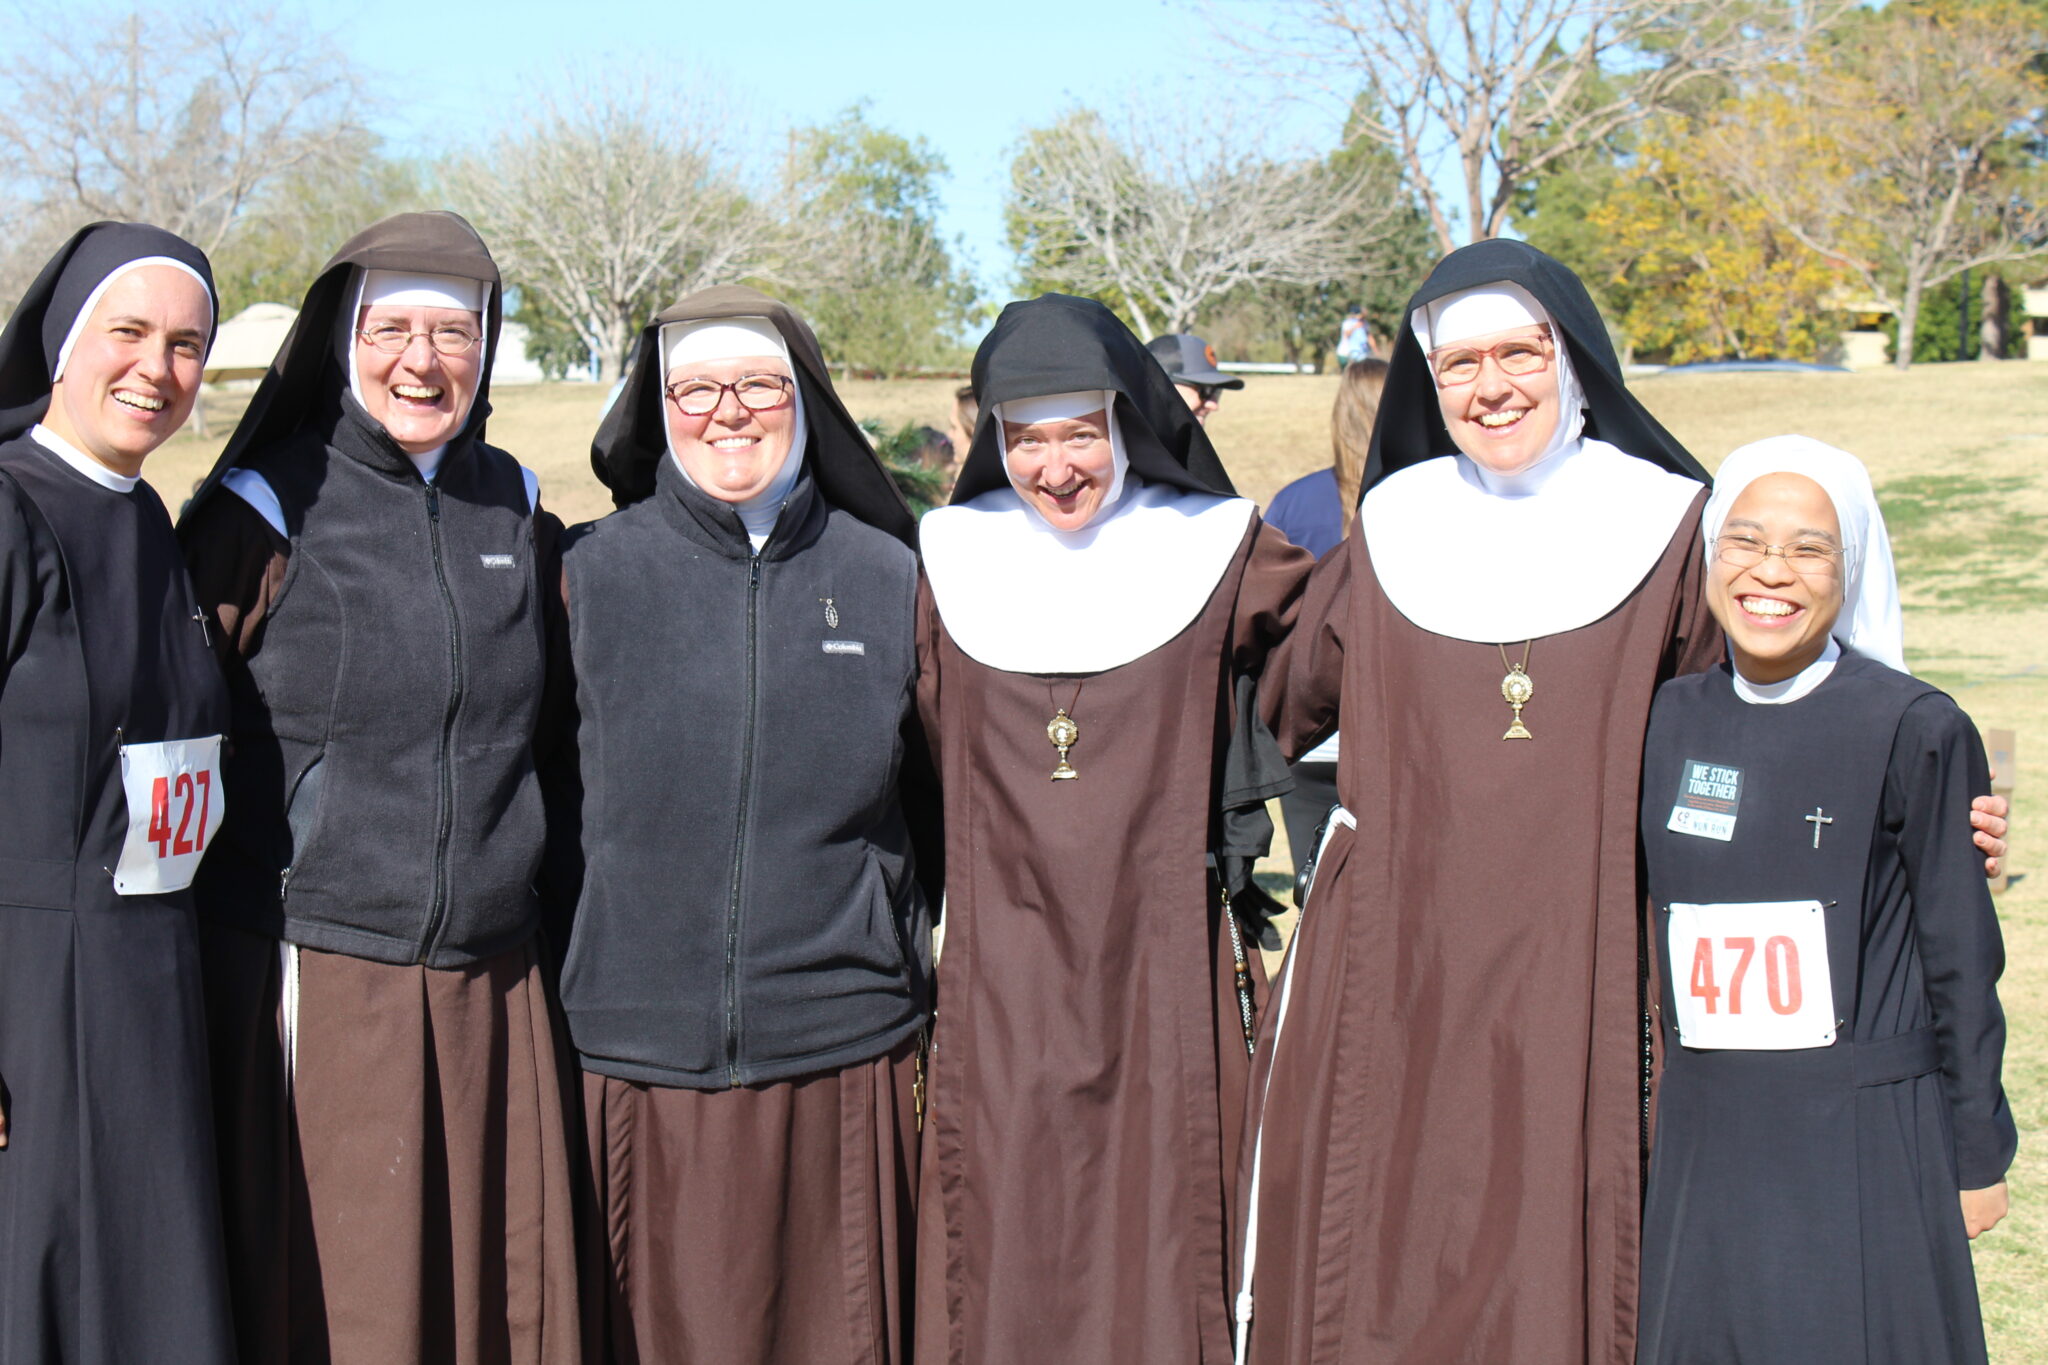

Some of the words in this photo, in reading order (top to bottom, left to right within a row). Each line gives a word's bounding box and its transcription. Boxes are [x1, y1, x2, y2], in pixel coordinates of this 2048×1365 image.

[1688, 778, 1737, 800] TOGETHER
[1692, 764, 1710, 780] WE
[1709, 767, 1740, 785] STICK
[148, 769, 210, 859] 427
[1690, 935, 1803, 1016] 470
